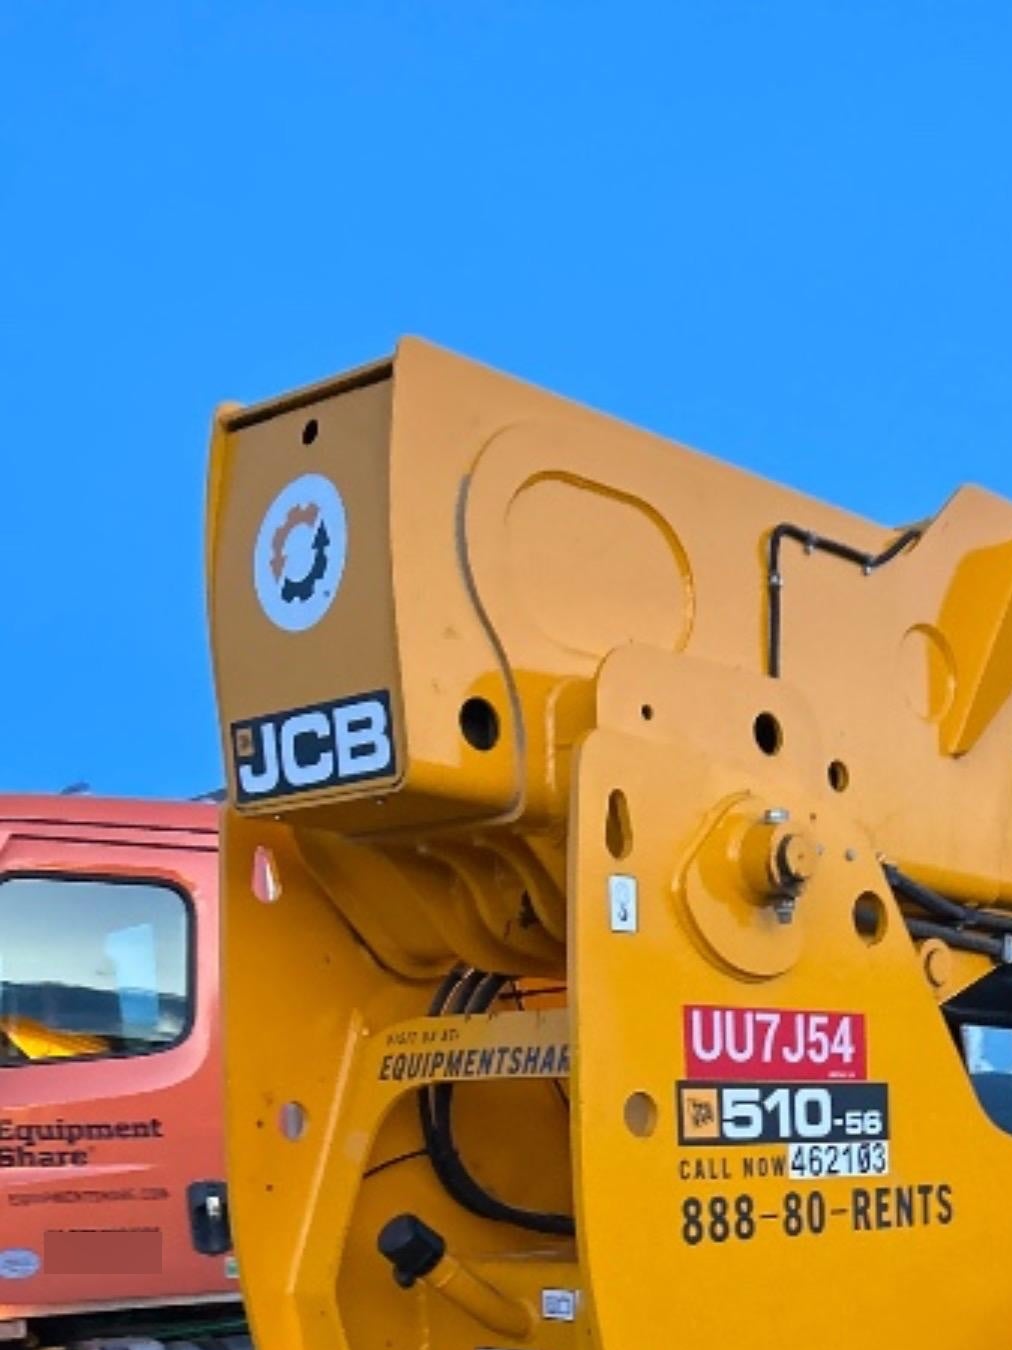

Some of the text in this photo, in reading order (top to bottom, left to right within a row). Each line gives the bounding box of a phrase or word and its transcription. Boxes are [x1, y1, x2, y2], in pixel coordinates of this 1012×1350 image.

[239, 700, 391, 794] JCB
[691, 1009, 856, 1064] UU7J54
[0, 1119, 164, 1146] Equipment
[721, 1087, 883, 1139] 510-56
[0, 1146, 88, 1167] Share
[679, 1155, 786, 1180] CALL NOW
[790, 1142, 886, 1177] 462103
[681, 1184, 954, 1246] 888-80-RENTS
